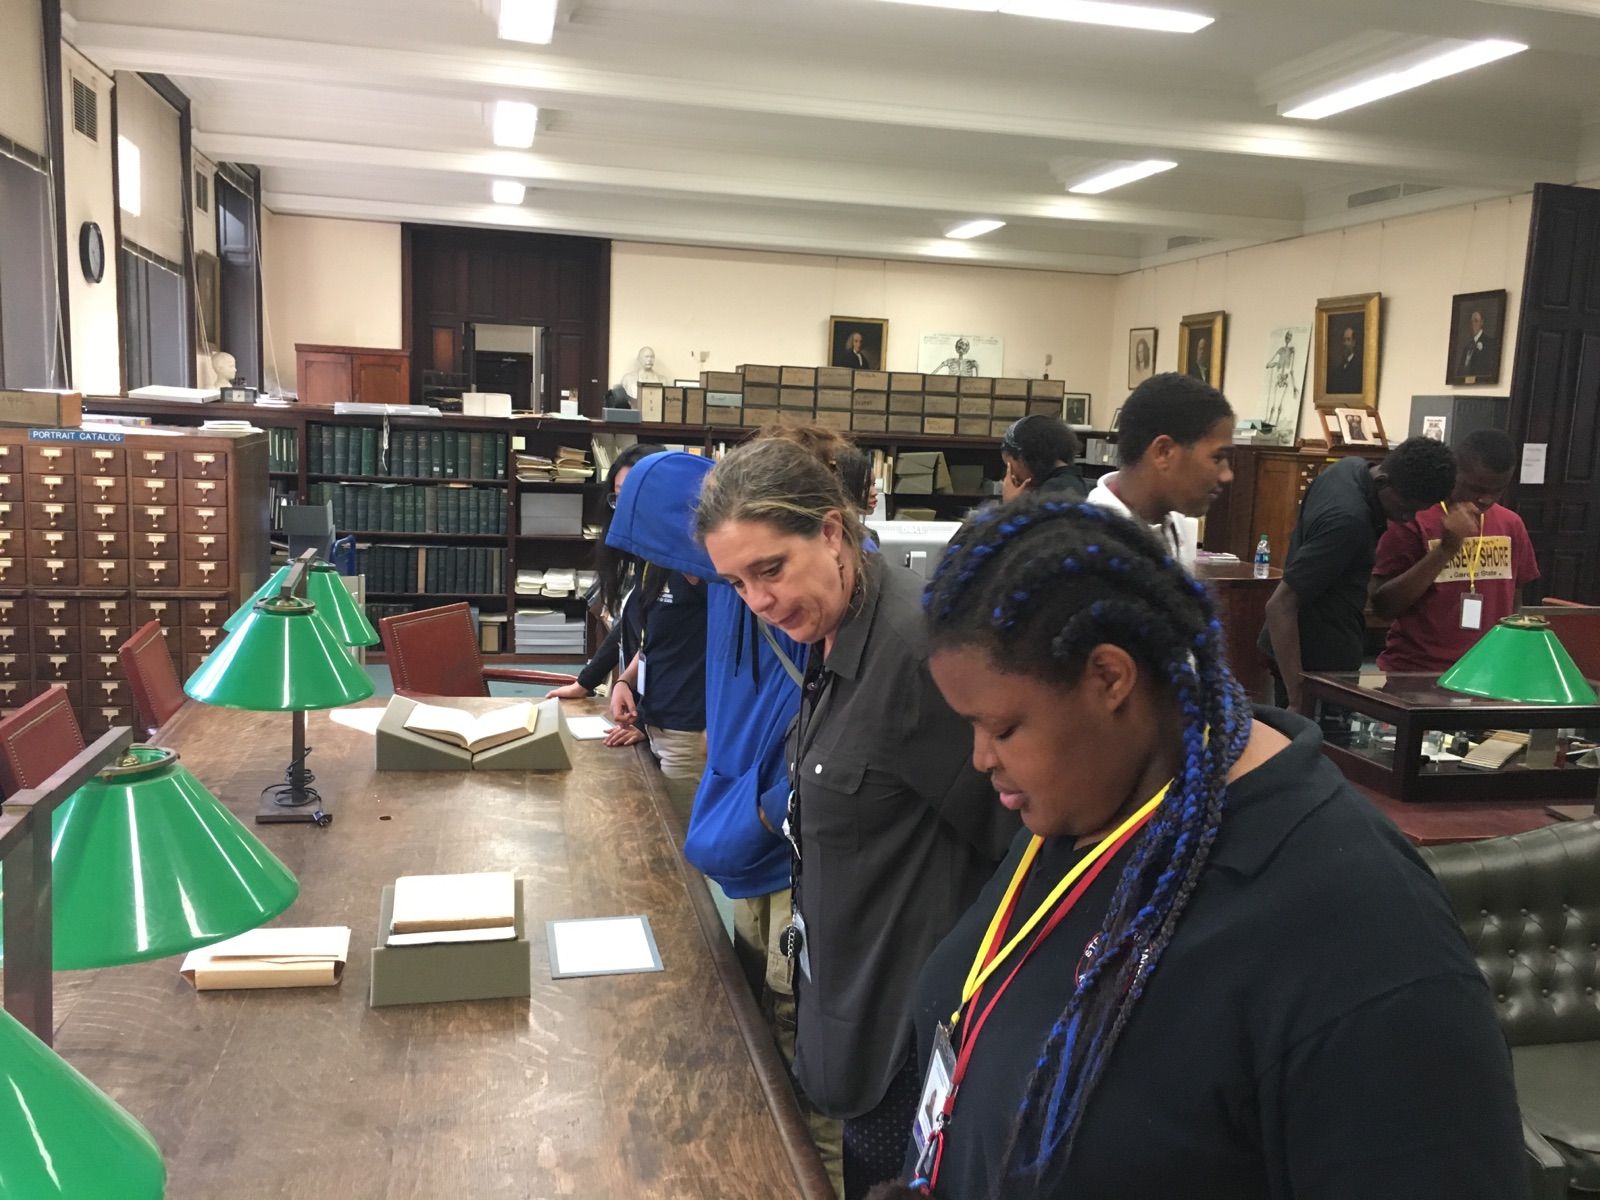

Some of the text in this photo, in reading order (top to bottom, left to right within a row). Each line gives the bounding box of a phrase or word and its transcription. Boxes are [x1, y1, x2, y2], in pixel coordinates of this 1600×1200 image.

[32, 431, 121, 442] PORTRAIT CATALOG
[1480, 546, 1508, 567] SHORE
